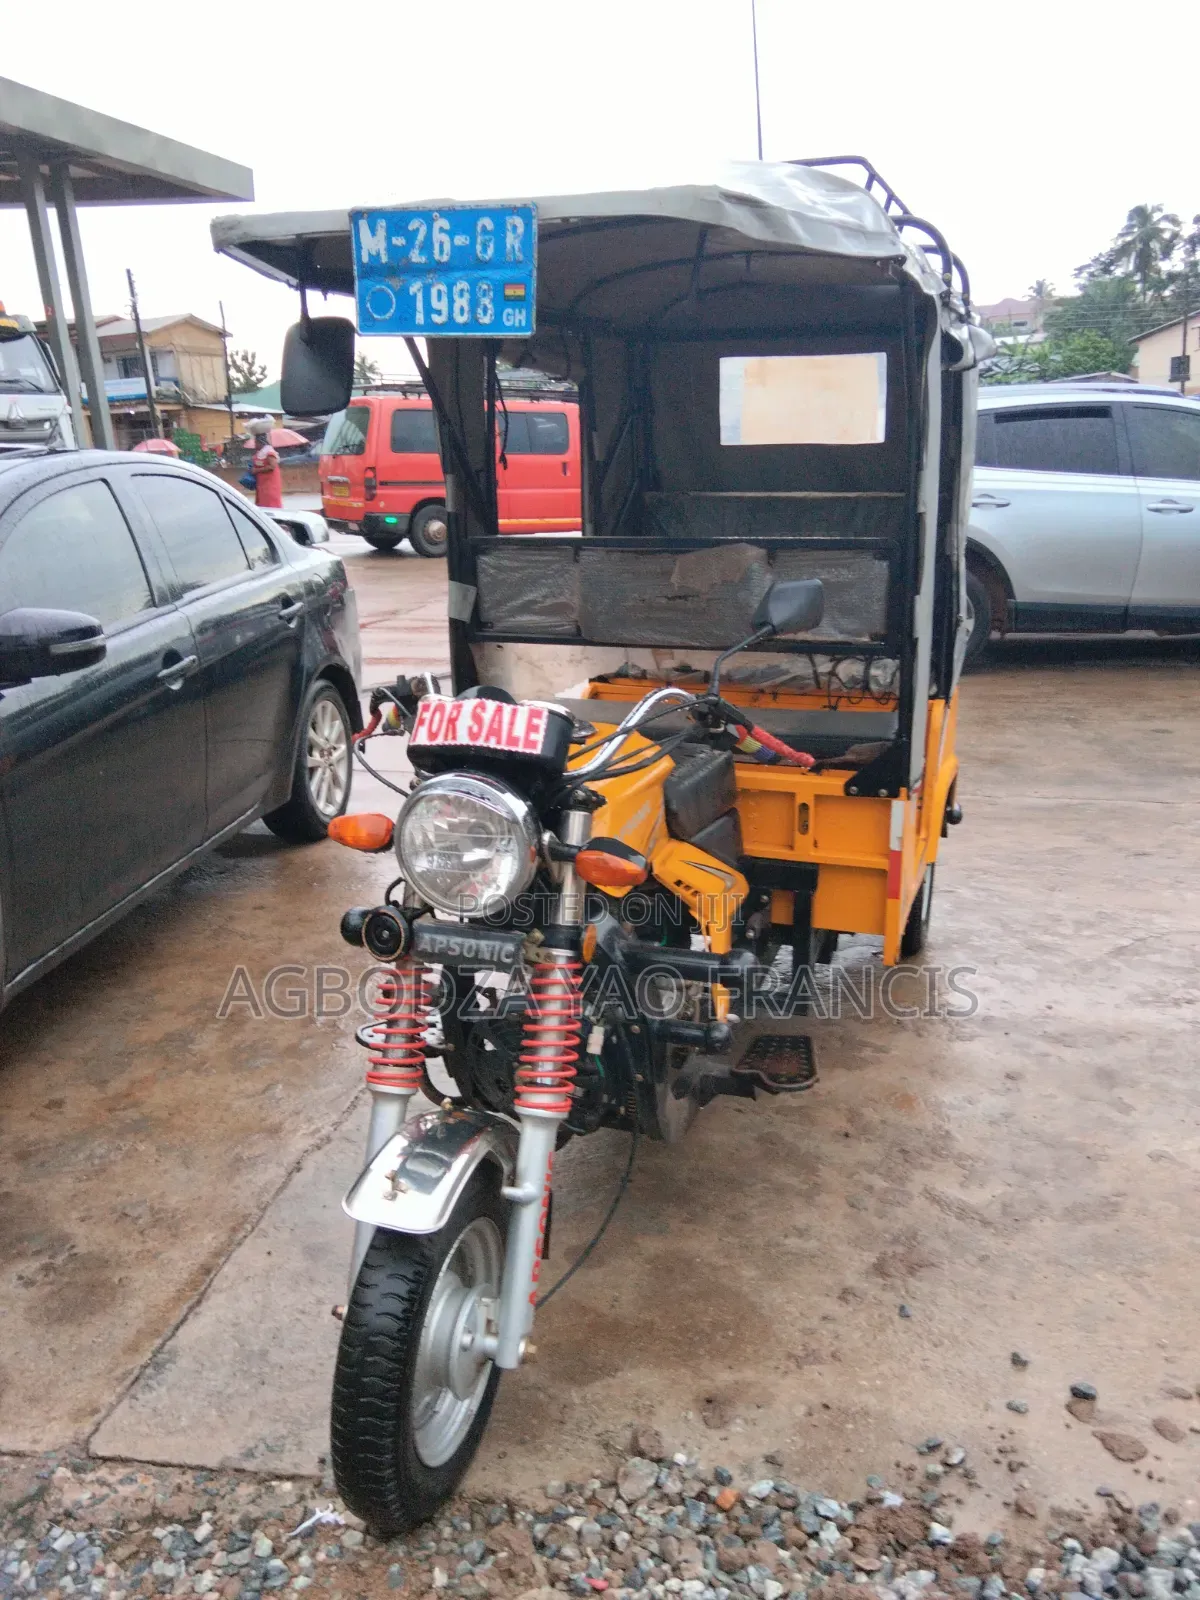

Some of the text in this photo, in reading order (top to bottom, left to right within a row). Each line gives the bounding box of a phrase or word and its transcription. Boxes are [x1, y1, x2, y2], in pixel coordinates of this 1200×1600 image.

[409, 279, 495, 326] 1988
[502, 308, 527, 328] GH
[411, 699, 544, 751] FOR SALE
[417, 933, 516, 964] APSONIC
